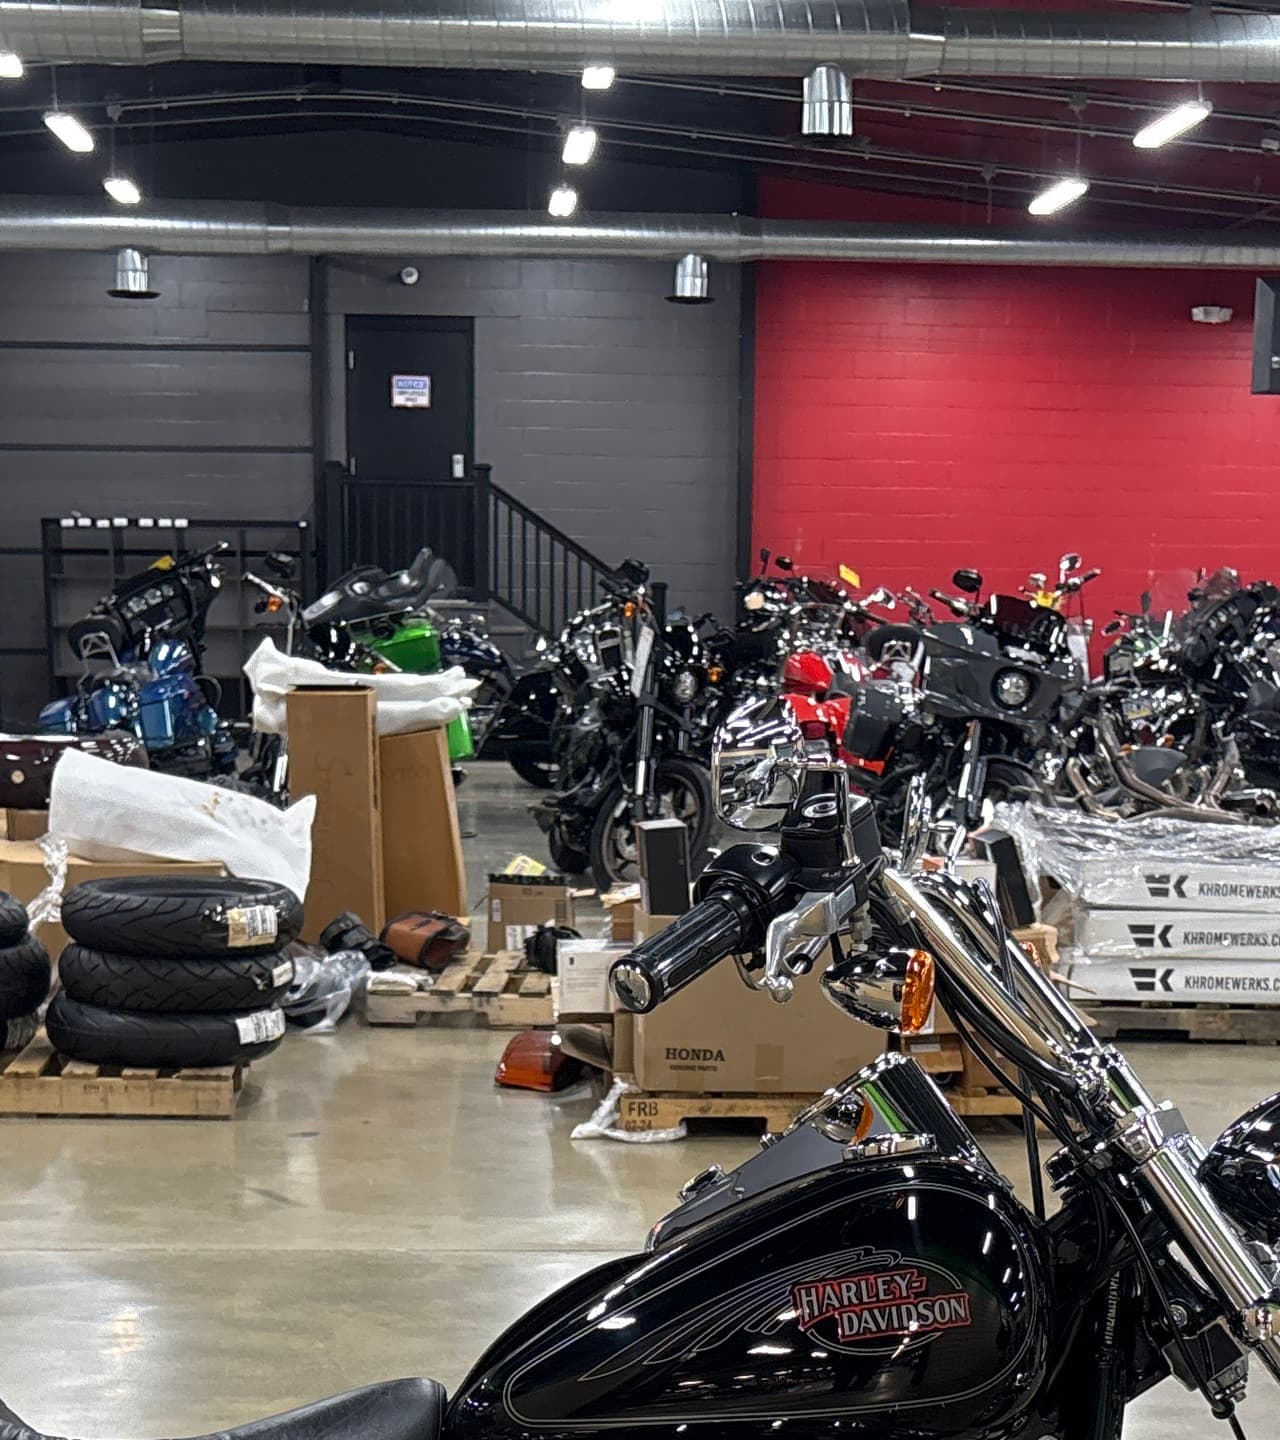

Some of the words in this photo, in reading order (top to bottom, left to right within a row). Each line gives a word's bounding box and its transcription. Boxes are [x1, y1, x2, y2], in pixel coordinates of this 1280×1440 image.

[665, 1048, 725, 1061] HONDA
[628, 1101, 659, 1117] FRB
[800, 1273, 922, 1322] HARLEY-
[842, 1296, 967, 1336] DAVIDSON
